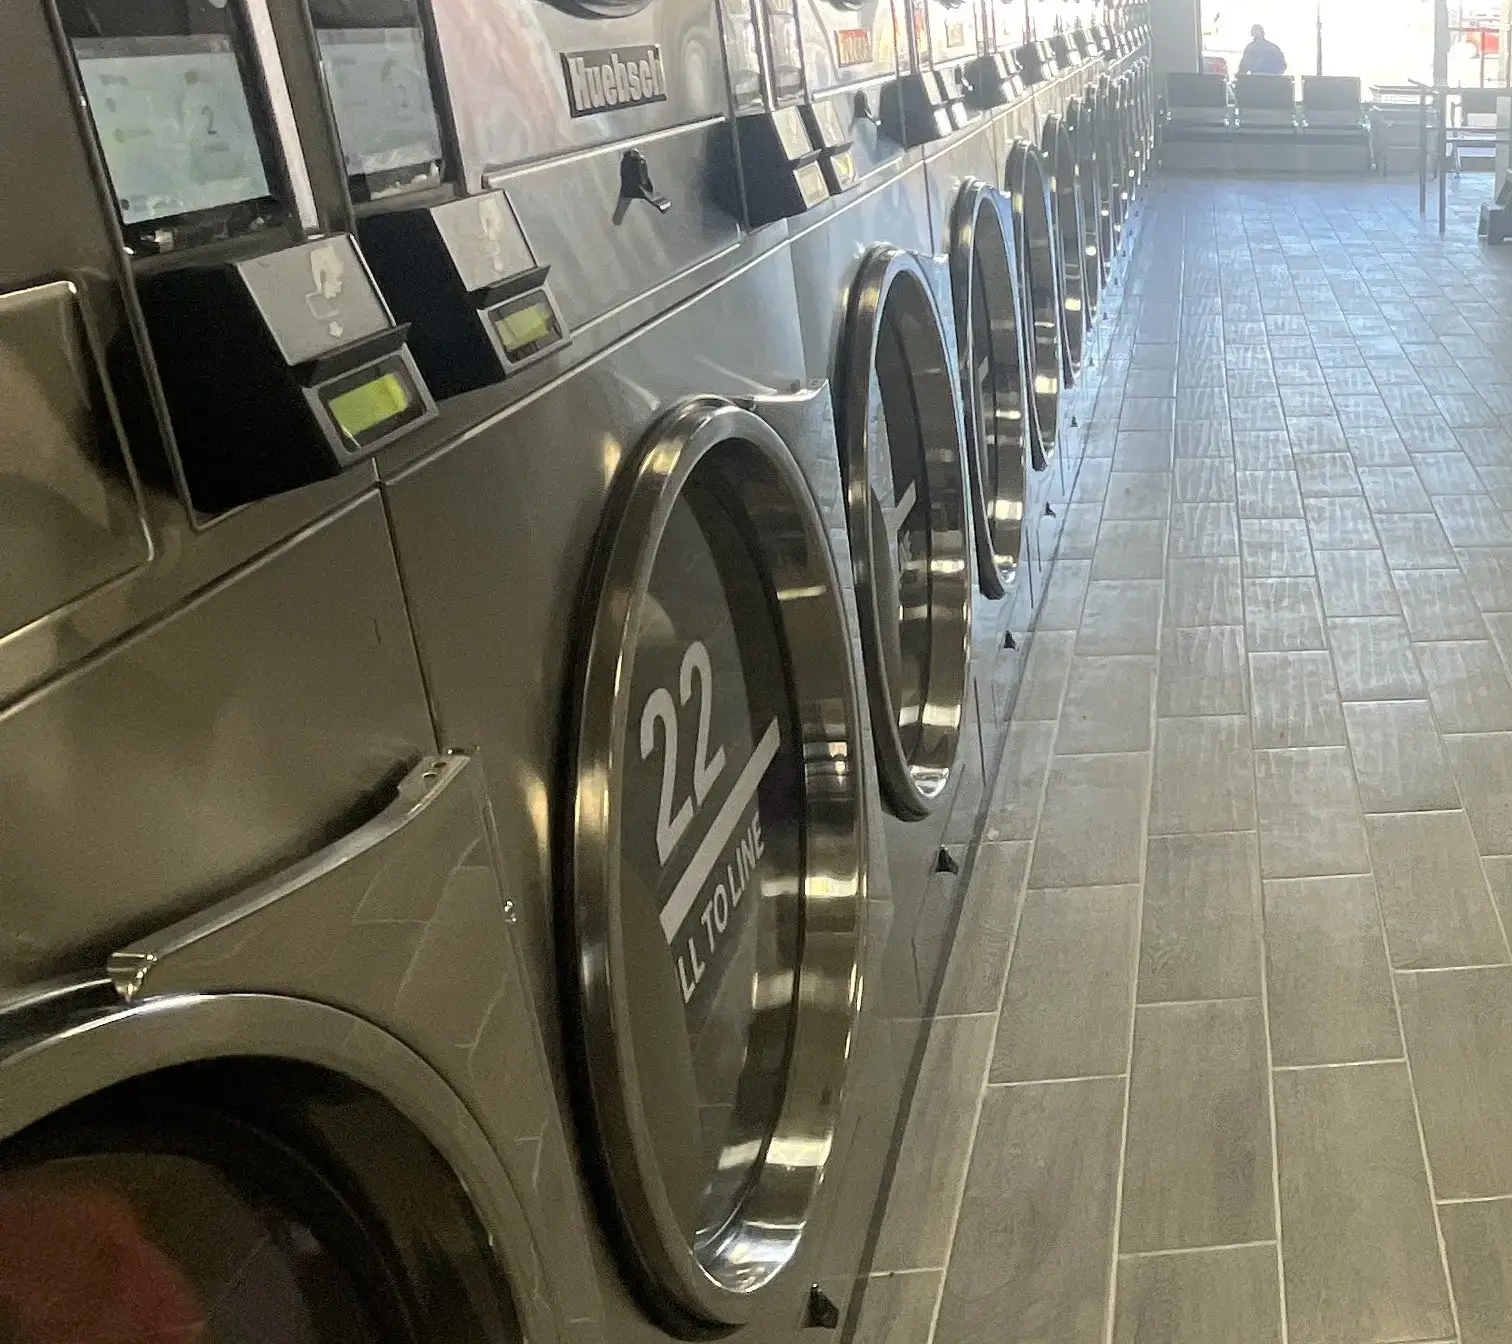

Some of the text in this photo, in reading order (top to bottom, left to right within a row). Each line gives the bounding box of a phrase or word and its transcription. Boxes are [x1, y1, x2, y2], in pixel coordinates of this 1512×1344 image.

[568, 49, 666, 111] Huebsch
[640, 641, 726, 867] 22
[676, 809, 764, 1004] LL TO LINE
